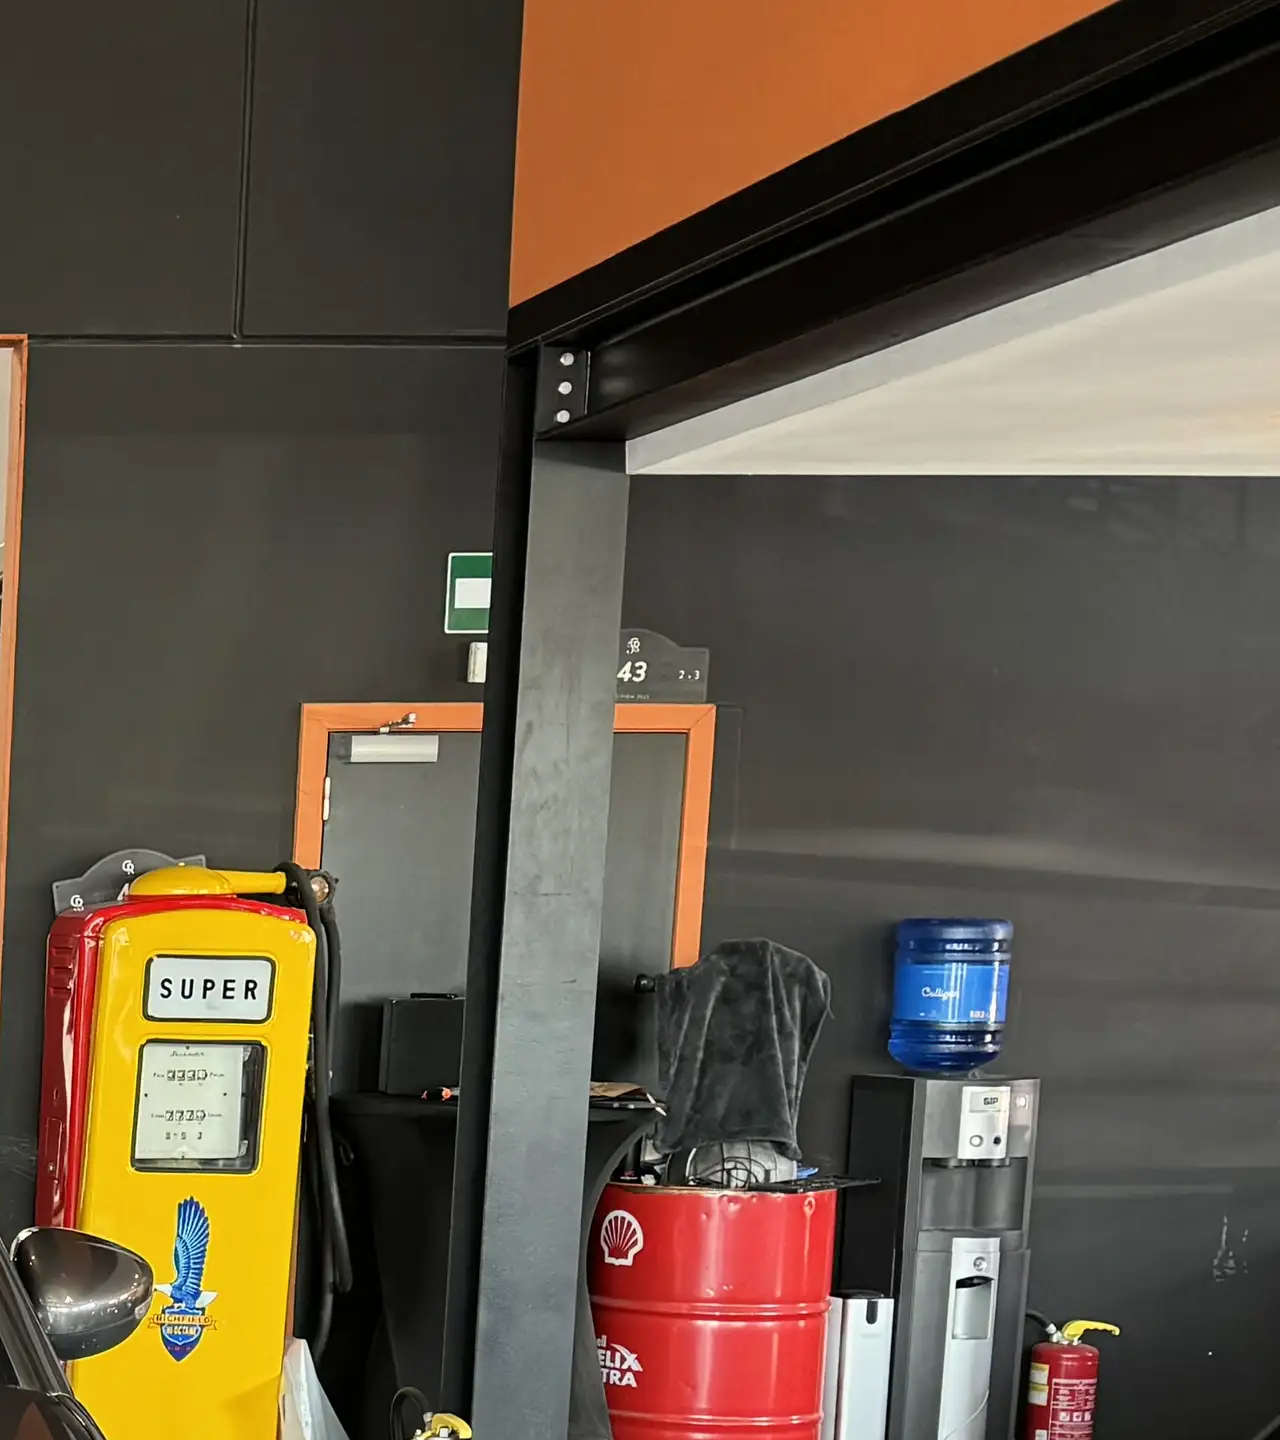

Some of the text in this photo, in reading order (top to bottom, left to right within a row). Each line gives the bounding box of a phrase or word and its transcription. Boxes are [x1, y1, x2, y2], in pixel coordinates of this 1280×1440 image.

[160, 978, 258, 1000] SUPER
[597, 1344, 643, 1372] ELIX
[600, 1368, 637, 1388] TRA
